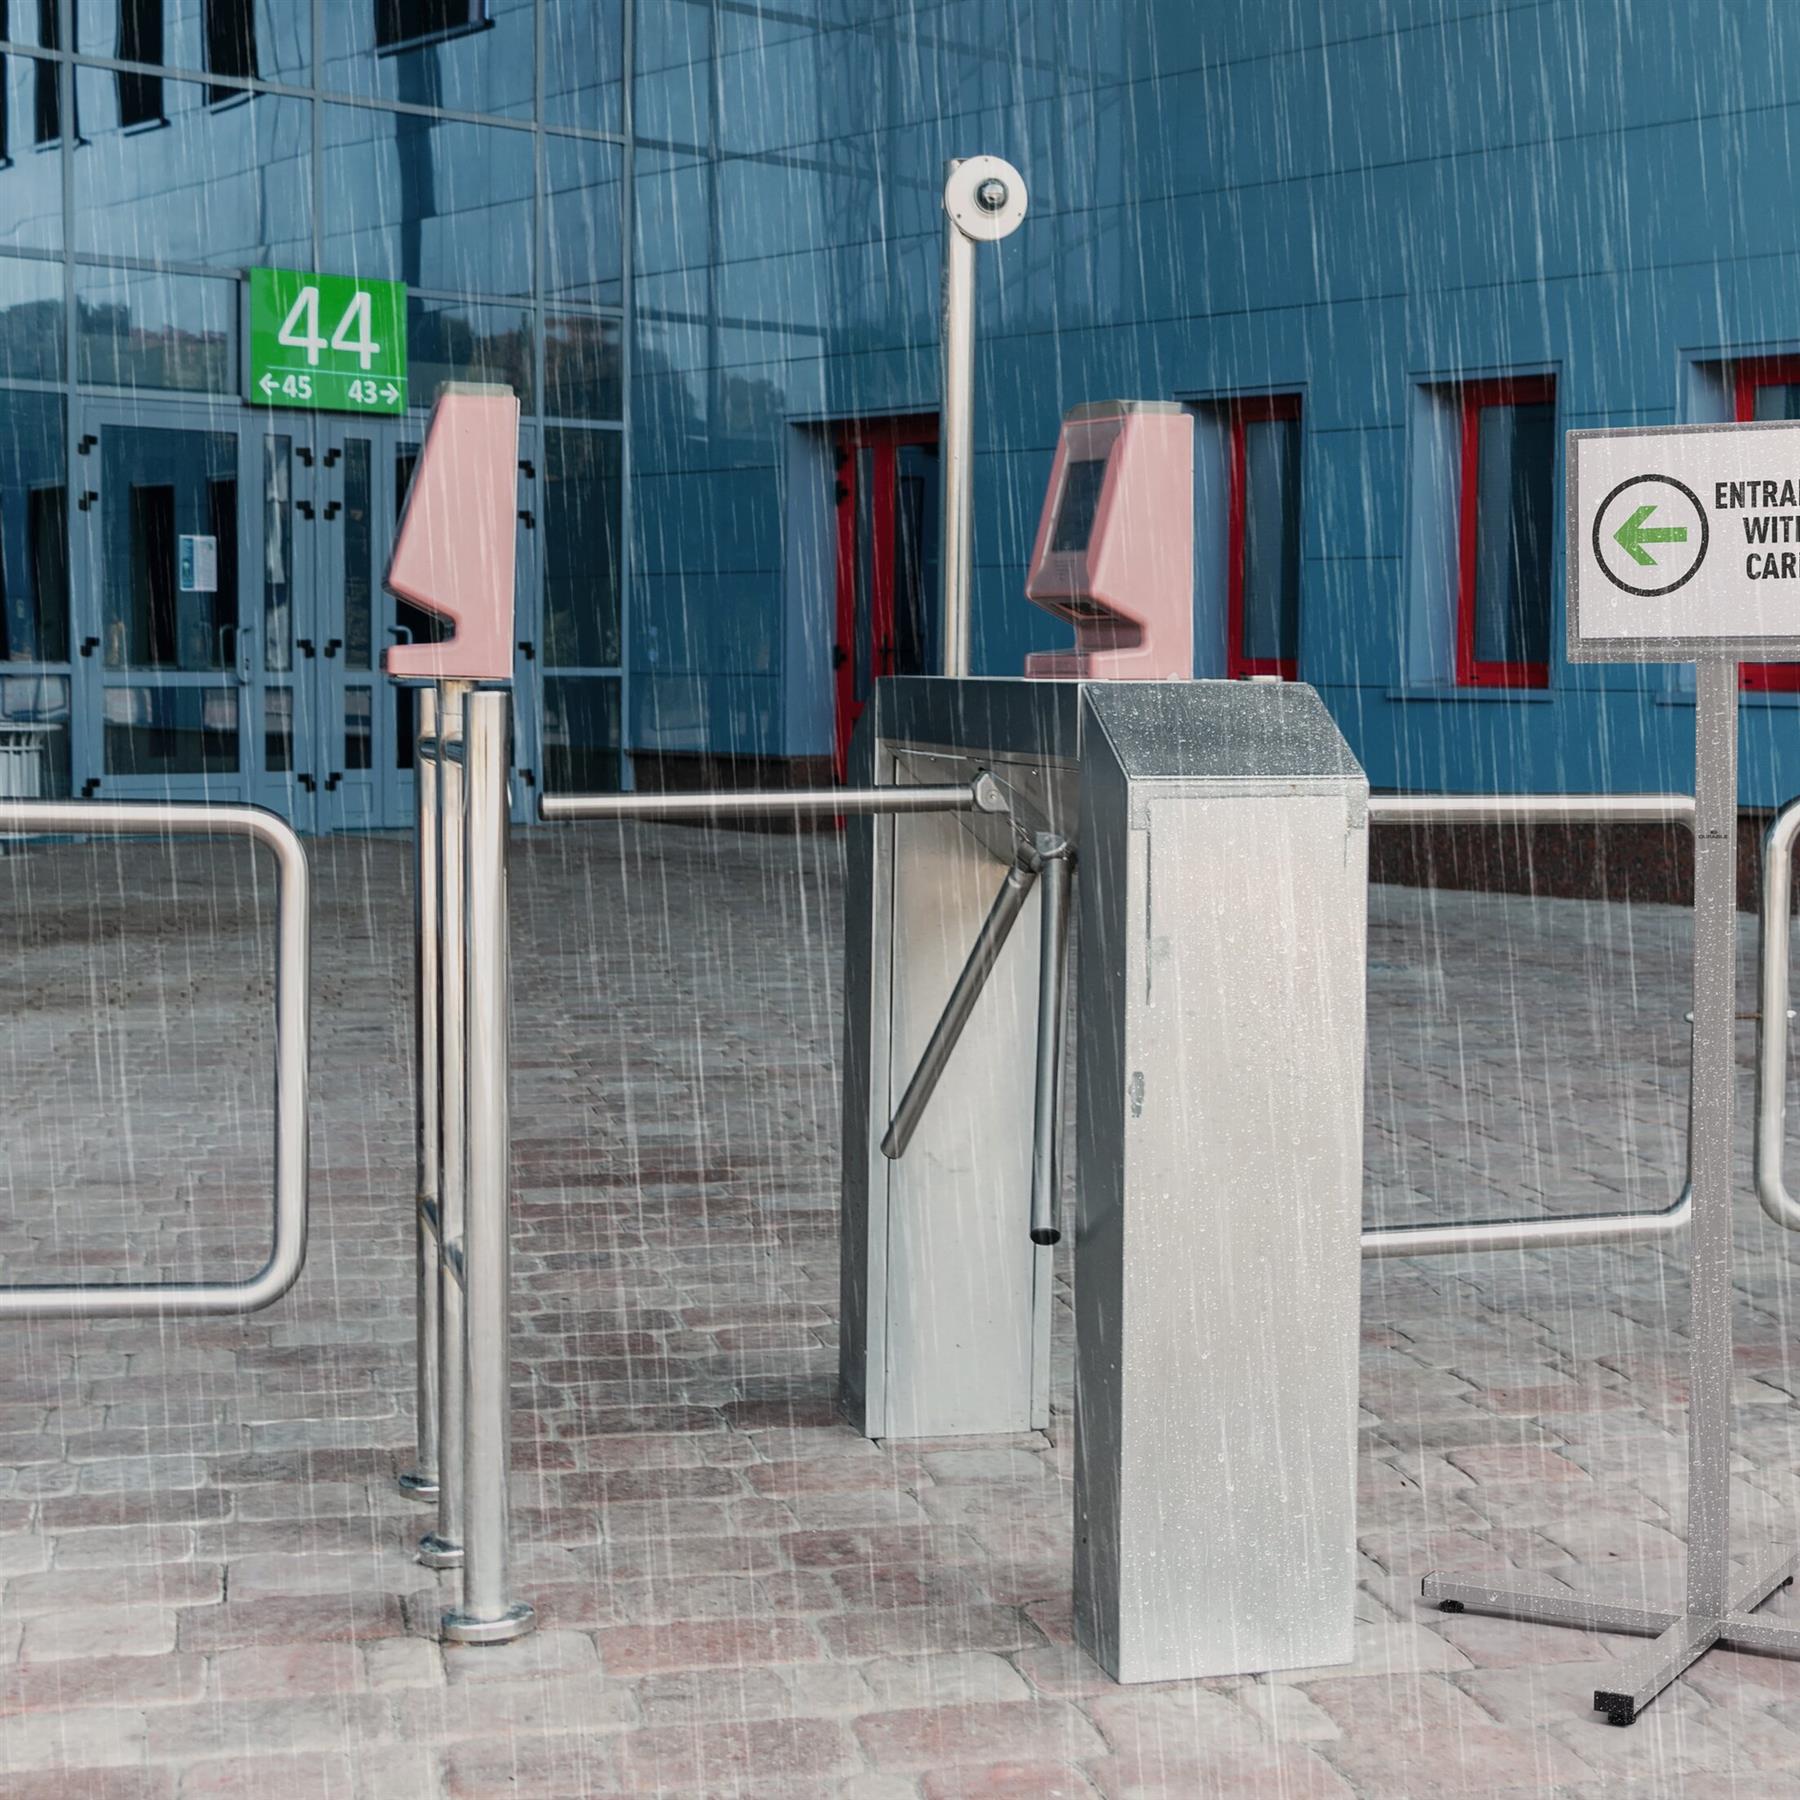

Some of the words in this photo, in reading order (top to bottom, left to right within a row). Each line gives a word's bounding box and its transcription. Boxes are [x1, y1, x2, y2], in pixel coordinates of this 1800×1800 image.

[278, 286, 380, 370] 44
[282, 374, 312, 399] 45
[348, 379, 378, 403] 43
[1715, 479, 1800, 509] ENTRA
[1746, 552, 1800, 580] CAR
